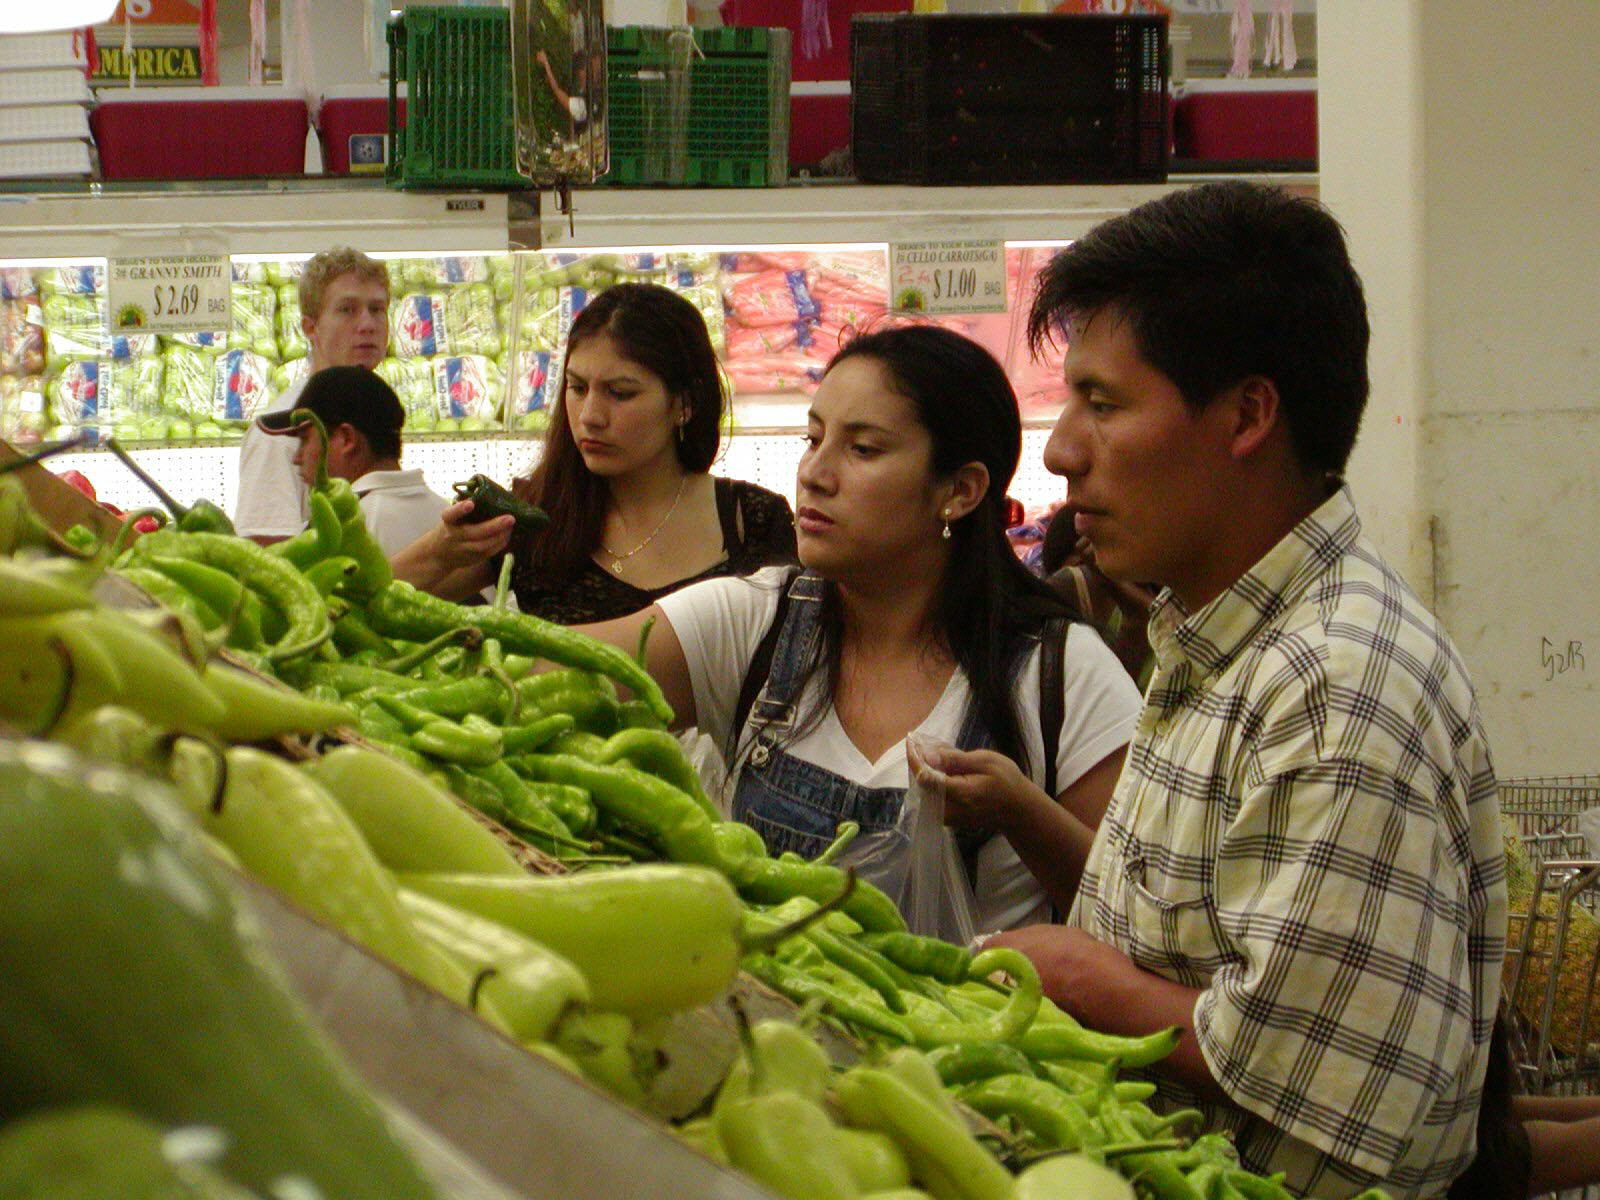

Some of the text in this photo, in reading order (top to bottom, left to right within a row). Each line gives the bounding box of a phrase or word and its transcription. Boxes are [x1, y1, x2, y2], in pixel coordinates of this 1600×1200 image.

[92, 48, 198, 75] MERICA
[907, 251, 937, 264] CELLO
[129, 267, 181, 280] GRANNY
[183, 265, 222, 278] SMITH
[984, 281, 1001, 295] BAG
[207, 298, 226, 313] BAG
